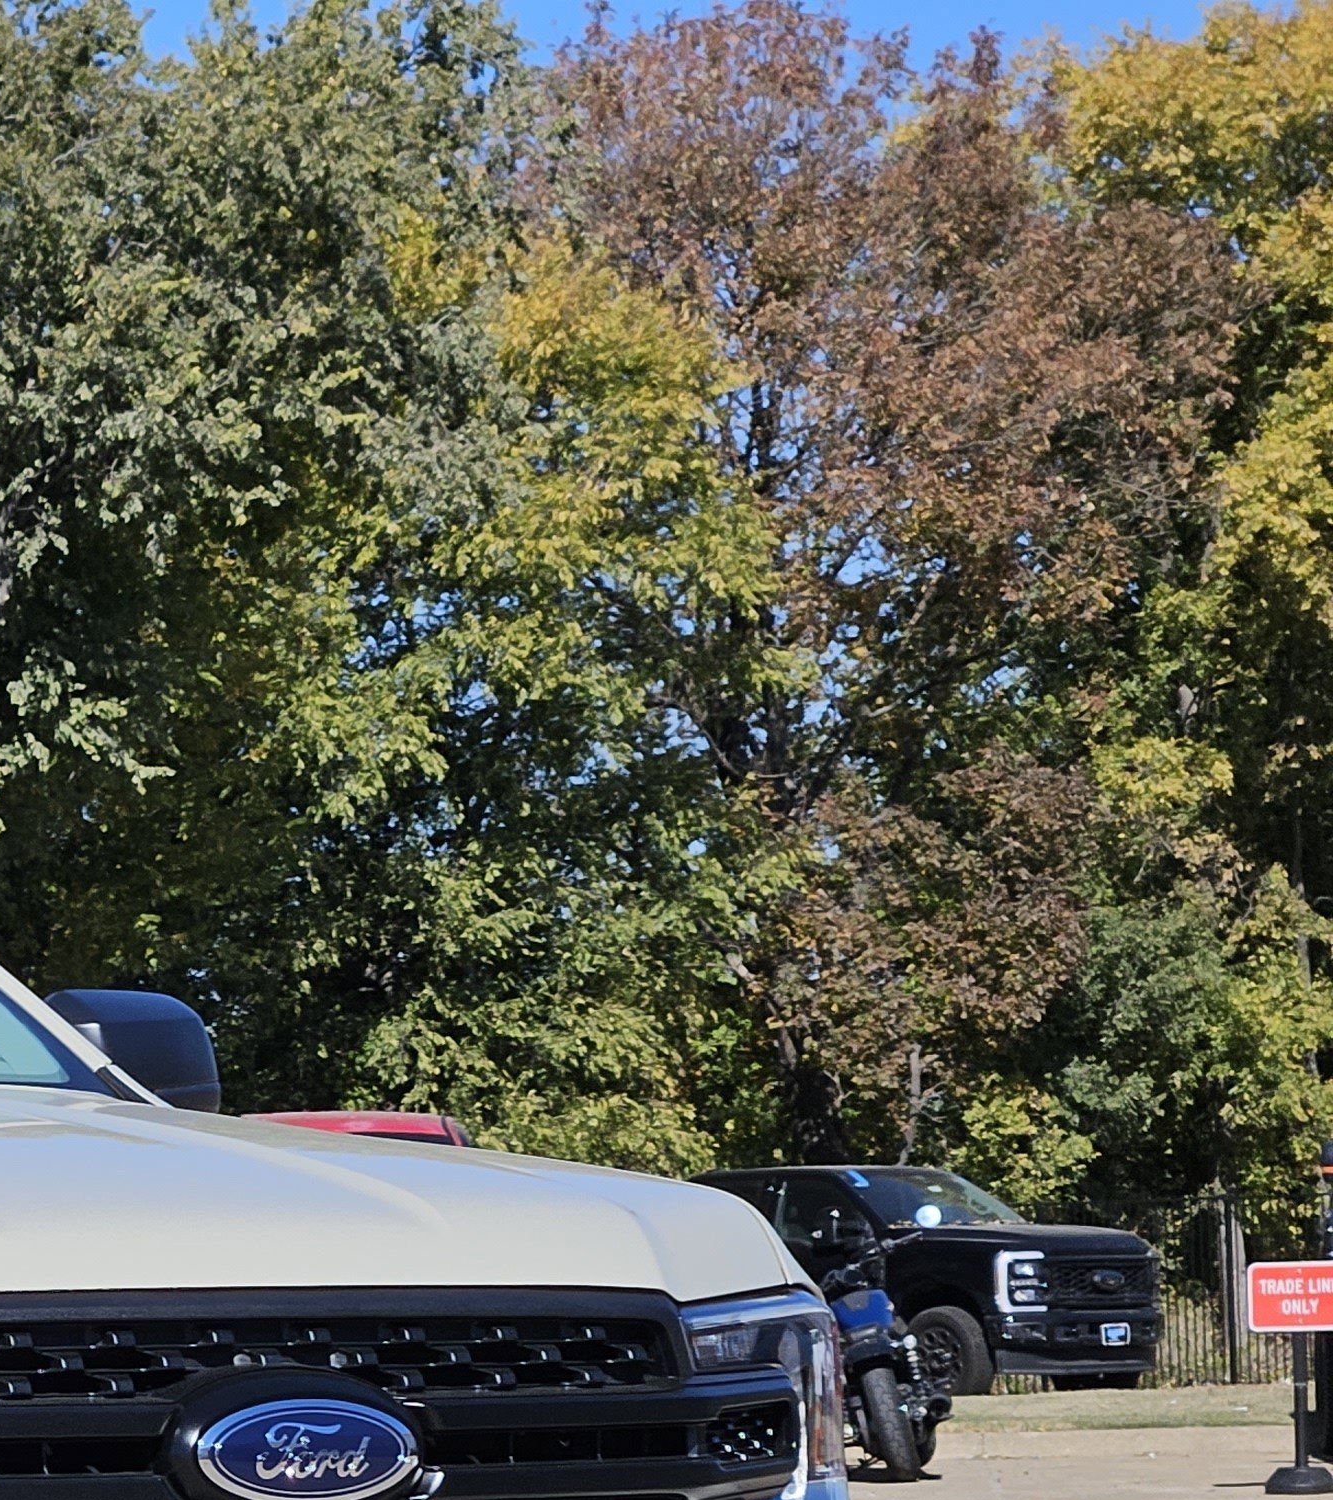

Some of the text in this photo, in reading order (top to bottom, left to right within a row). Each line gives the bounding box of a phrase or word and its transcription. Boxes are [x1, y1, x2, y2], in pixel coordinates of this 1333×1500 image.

[1259, 1276, 1333, 1296] TRADE LIN
[1281, 1298, 1319, 1315] ONLY
[255, 1421, 372, 1481] Ford
